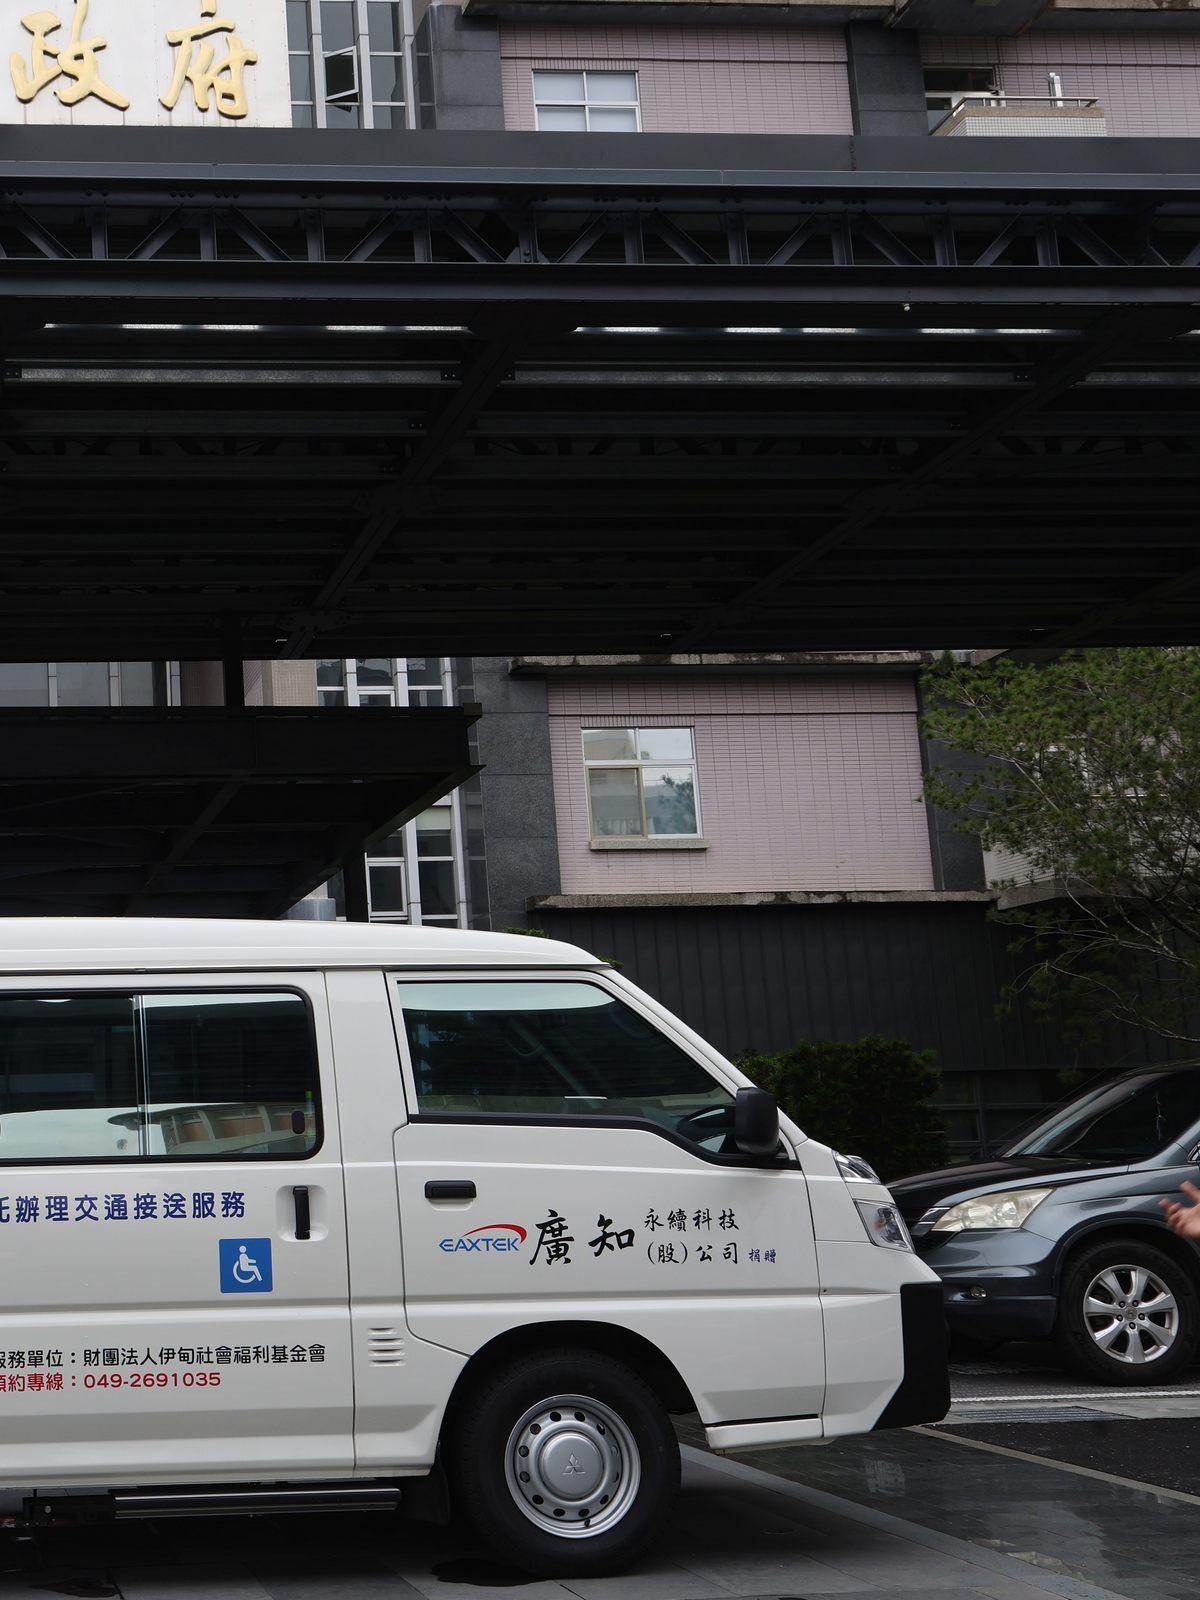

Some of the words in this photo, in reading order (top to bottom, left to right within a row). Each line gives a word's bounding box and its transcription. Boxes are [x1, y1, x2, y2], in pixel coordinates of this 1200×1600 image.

[643, 1207, 740, 1233] 永續科技
[439, 1237, 521, 1252] EAXTEK
[529, 1208, 636, 1267] 廣知
[748, 1247, 777, 1264] 捐贈
